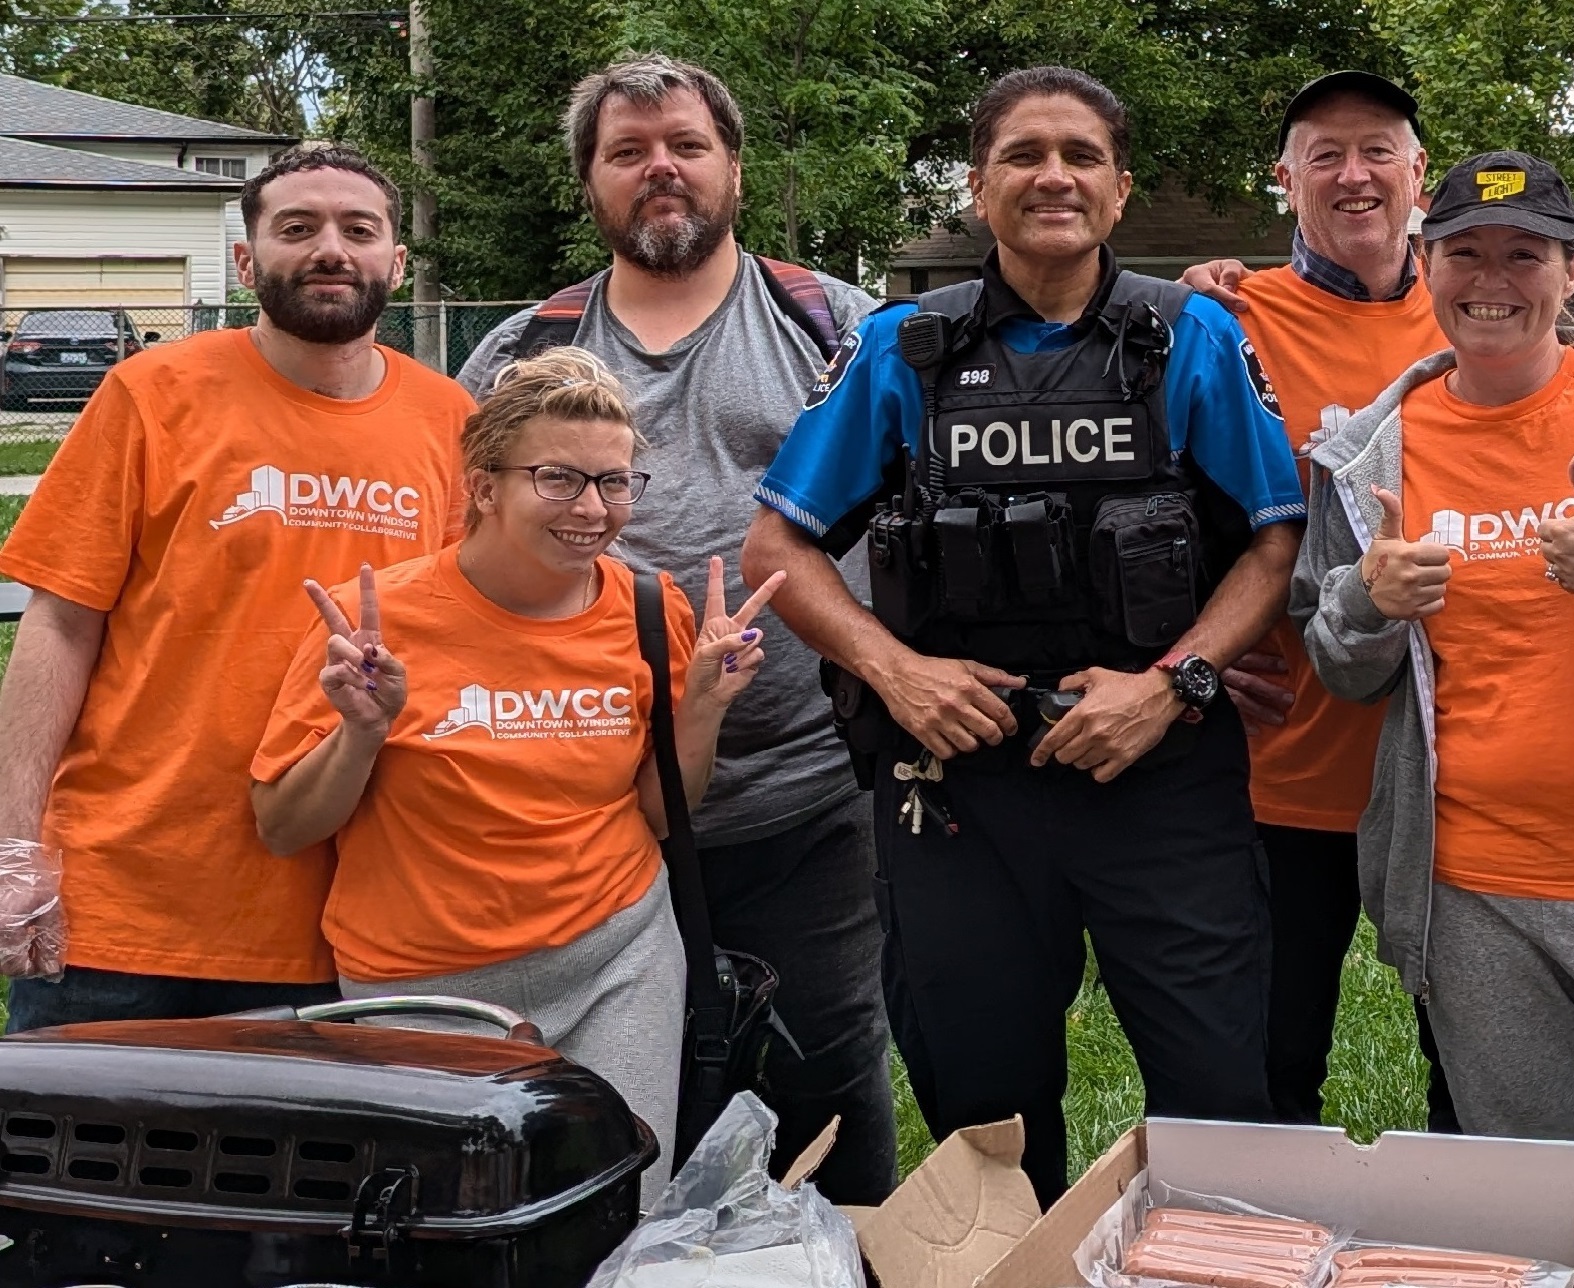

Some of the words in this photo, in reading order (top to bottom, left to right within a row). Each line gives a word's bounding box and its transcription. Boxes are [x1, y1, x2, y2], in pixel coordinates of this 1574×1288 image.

[1486, 173, 1516, 182] STREET
[1488, 182, 1514, 197] LIGHT
[959, 369, 990, 385] 598
[812, 383, 831, 392] LICE
[951, 417, 1135, 468] POLICE
[289, 473, 420, 518] DWCC
[289, 506, 365, 521] DOWNTOWN
[367, 512, 419, 530] WINDSOR
[288, 518, 348, 530] COMMUNITY
[348, 523, 417, 541] COLLABORATIVE
[1469, 547, 1542, 561] COMMUNTY
[494, 687, 632, 719] DWCC
[496, 720, 573, 730] DOWNTOWN
[576, 717, 631, 728] WINDSOR
[496, 731, 555, 740] COMMUNITY
[558, 728, 631, 738] COLLABORATIVE
